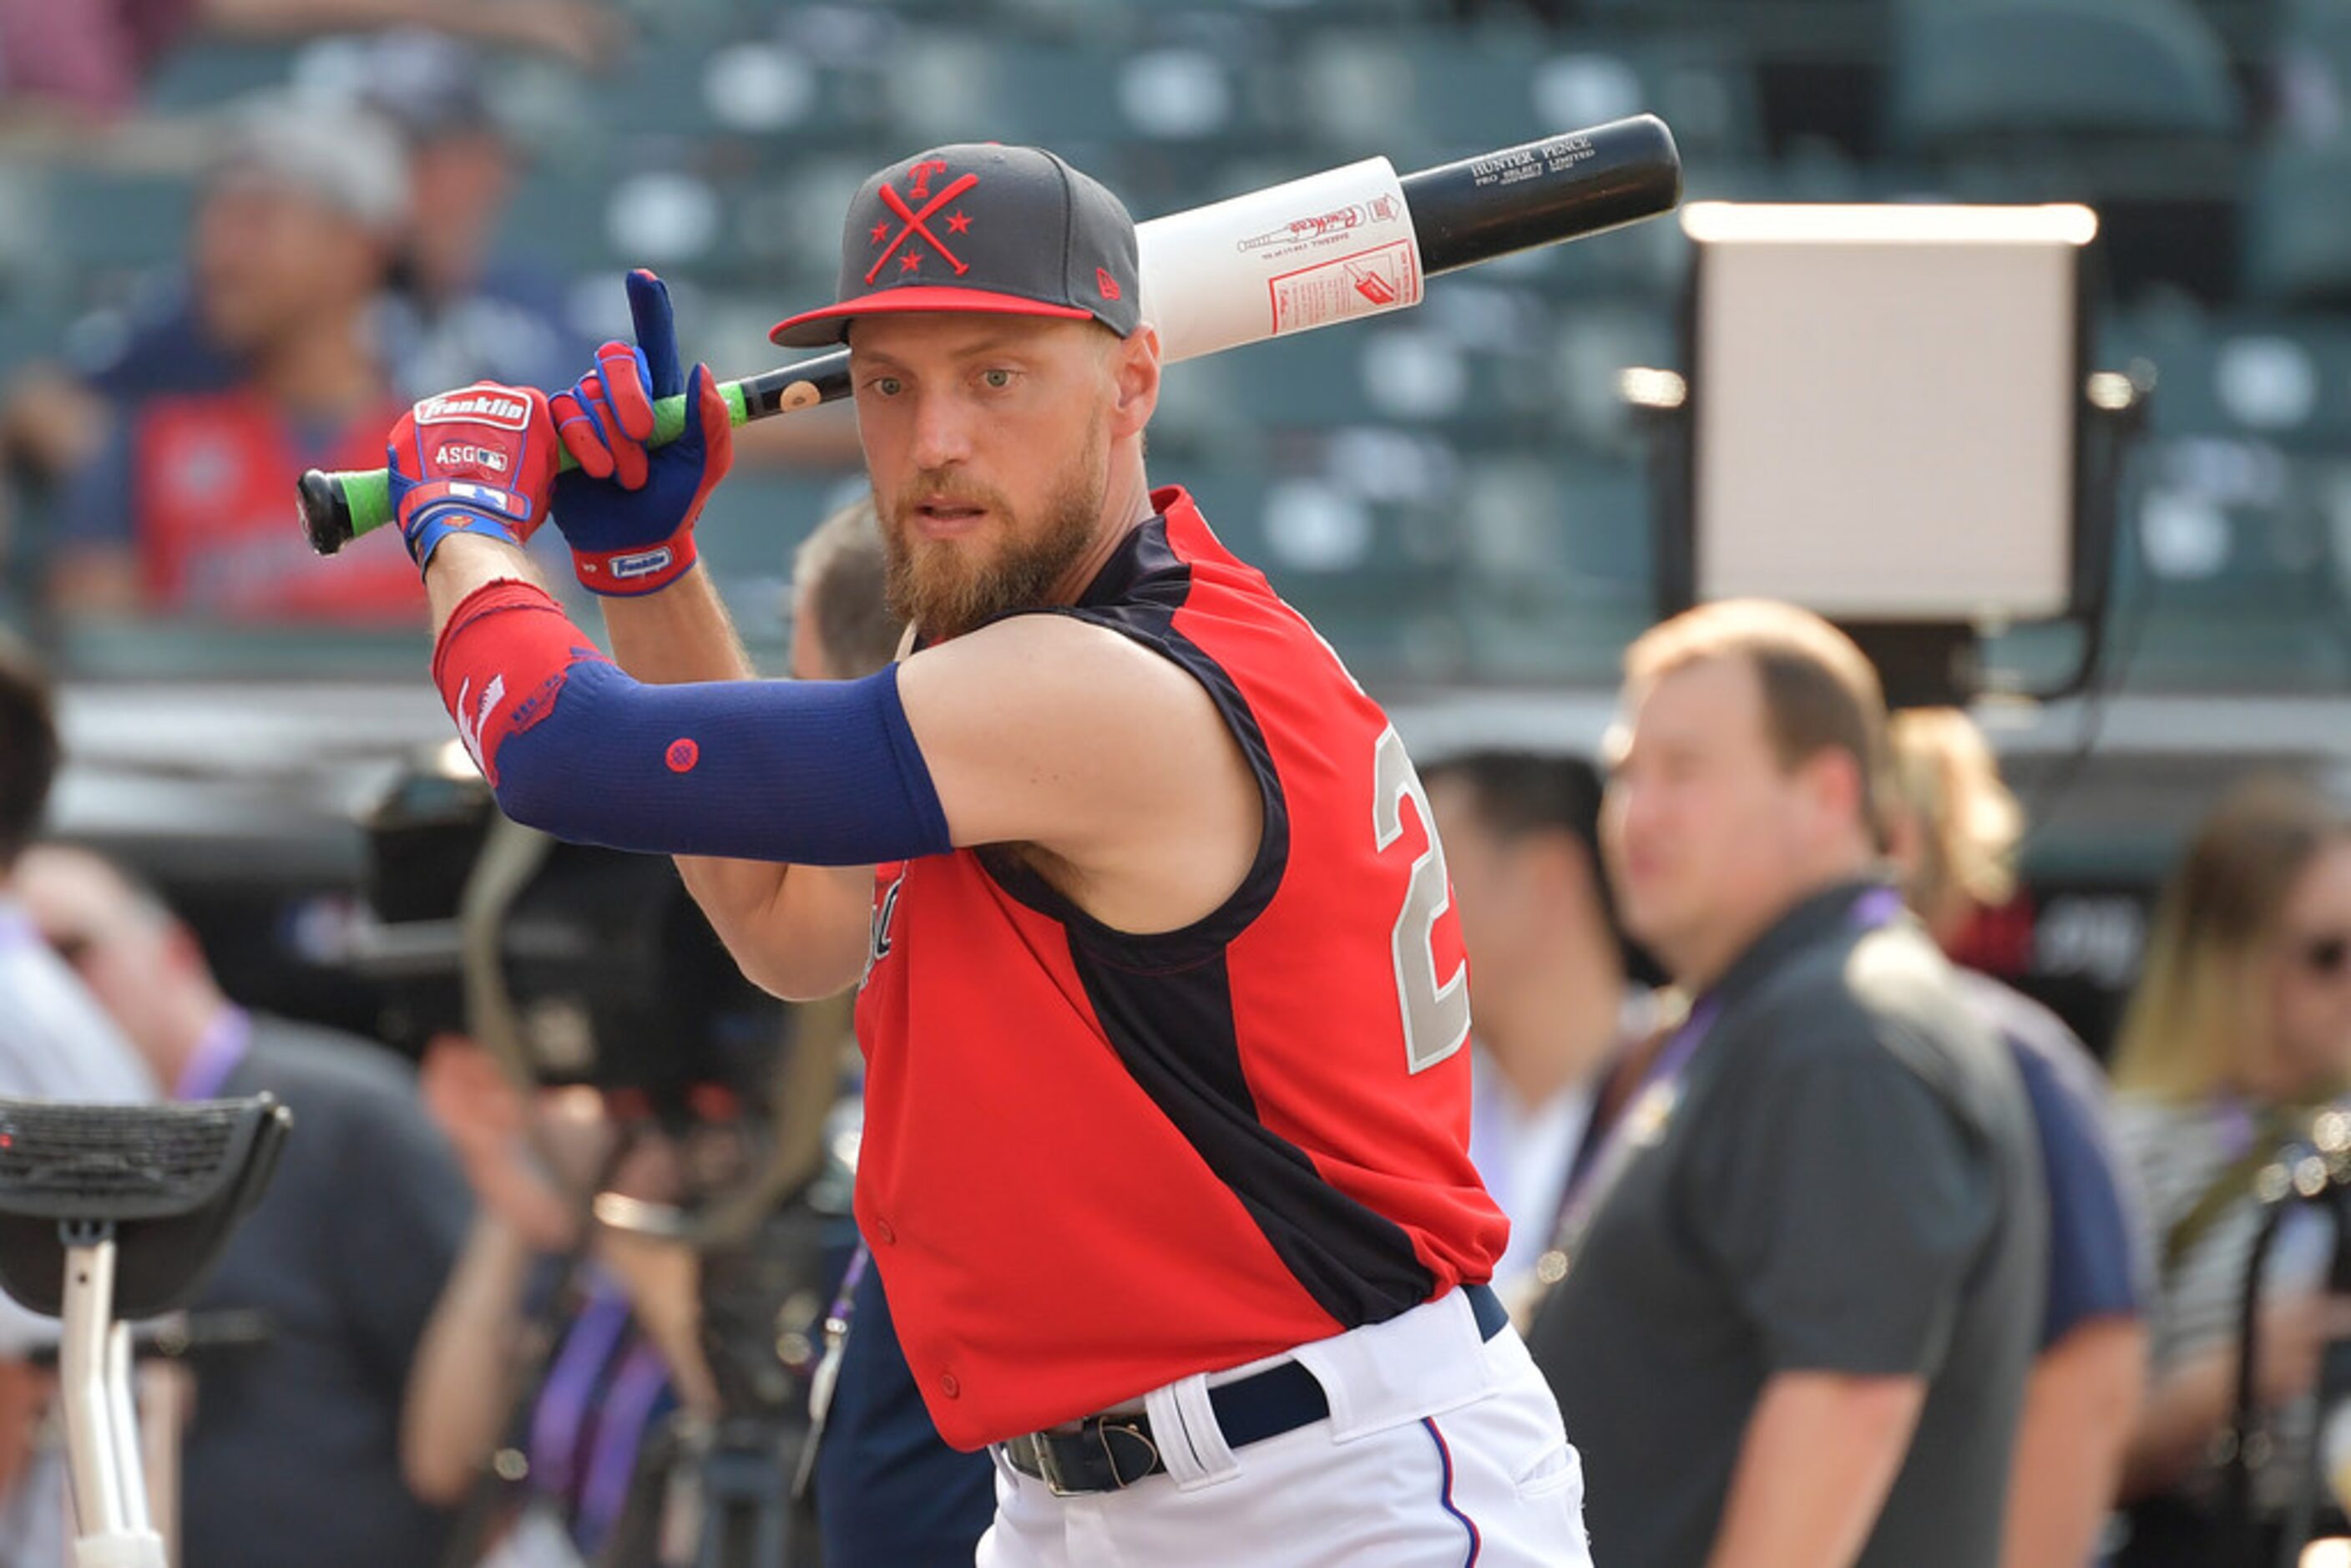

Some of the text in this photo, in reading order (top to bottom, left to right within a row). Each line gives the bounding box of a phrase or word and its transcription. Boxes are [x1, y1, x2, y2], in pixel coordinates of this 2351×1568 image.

[1471, 151, 1535, 178] HUNTER
[1542, 136, 1592, 159] PENCE
[1475, 174, 1499, 186] PRO
[1549, 149, 1596, 166] LIMITED
[908, 159, 948, 200] T
[420, 395, 524, 419] Franklin
[435, 445, 475, 464] ASG
[618, 555, 665, 576] Franklin
